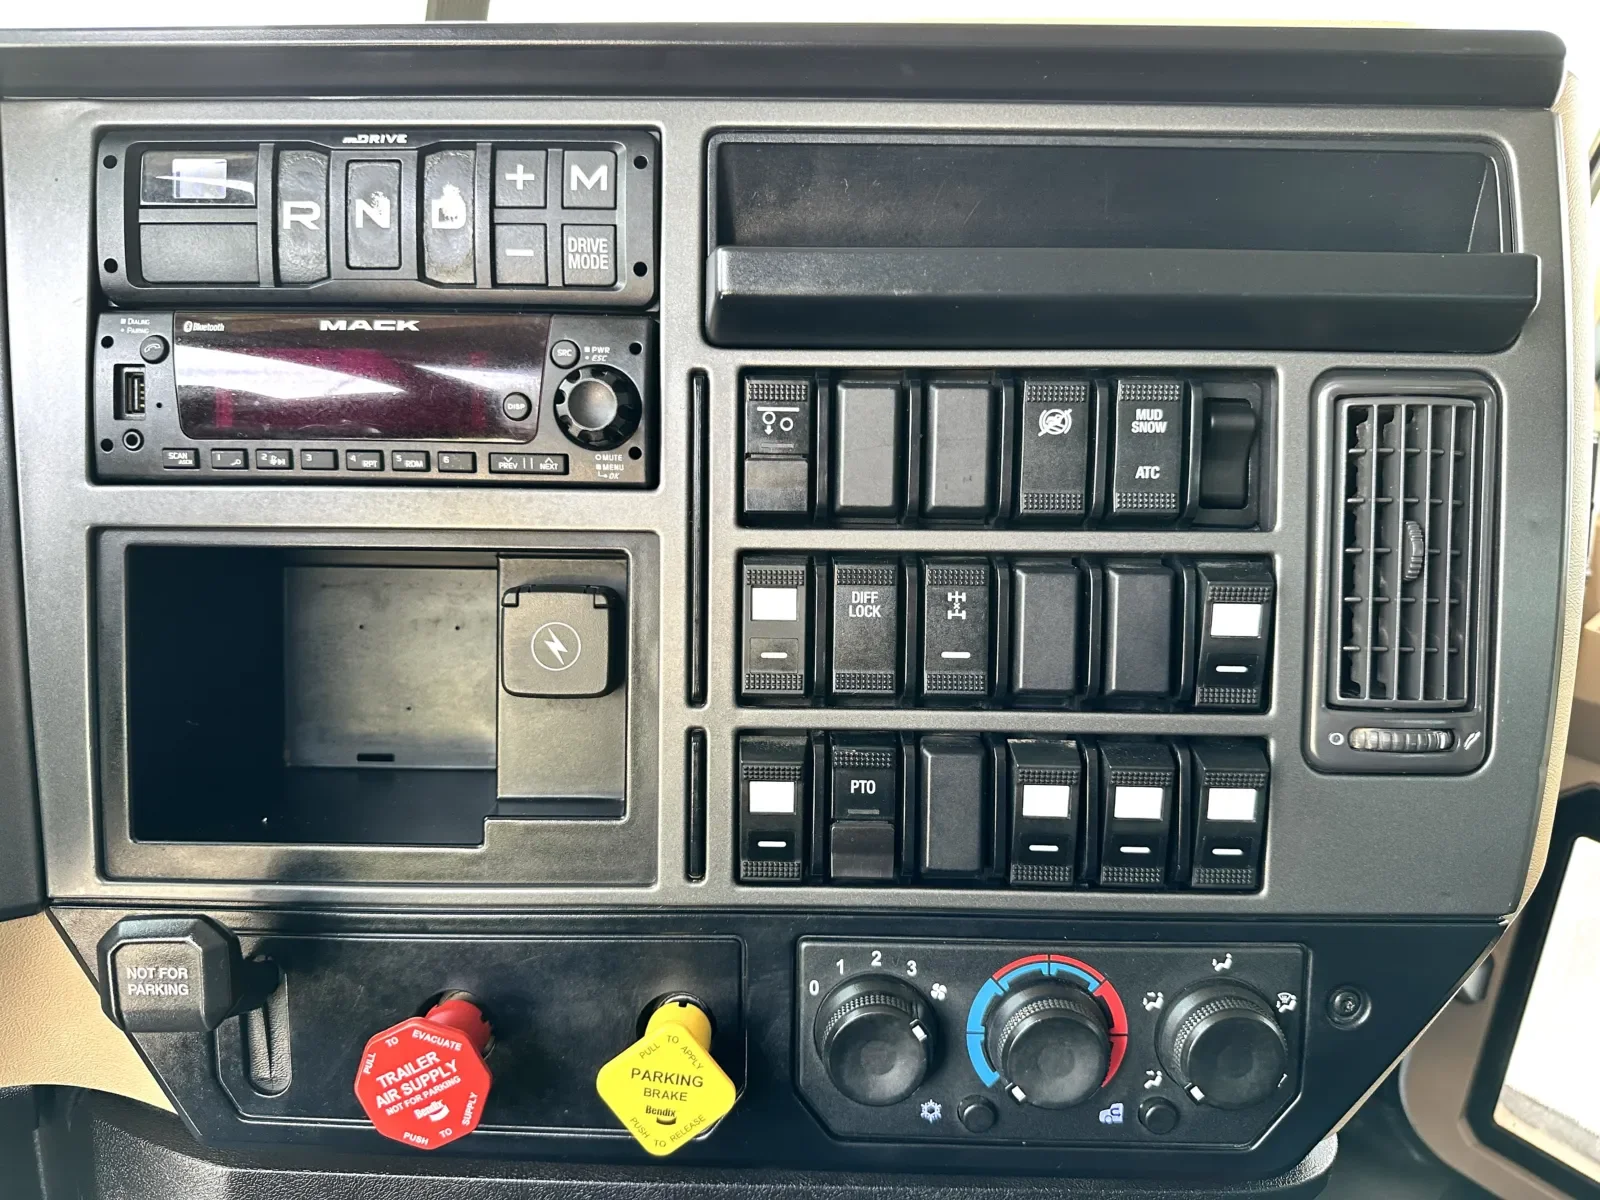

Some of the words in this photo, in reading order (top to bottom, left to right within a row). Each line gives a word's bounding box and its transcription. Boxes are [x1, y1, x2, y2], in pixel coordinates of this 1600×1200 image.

[570, 164, 608, 191] M
[282, 201, 321, 229] R
[355, 198, 391, 229] N
[431, 198, 467, 229] D
[568, 237, 608, 253] DRIVE
[568, 253, 609, 270] MODE
[193, 322, 225, 332] Bluetooth
[319, 320, 421, 331] MACK
[557, 349, 573, 357] SRC
[591, 346, 611, 354] PWR
[1135, 408, 1164, 421] MUD
[1131, 420, 1168, 434] SNOW
[168, 452, 188, 460] SCAN
[216, 453, 221, 461] 1
[261, 453, 268, 461] 2
[306, 453, 313, 462] 3
[443, 456, 450, 464] 6
[602, 454, 623, 462] MUTE
[361, 460, 378, 468] RPT
[404, 460, 424, 468] RDM
[498, 462, 518, 470] PREV
[539, 463, 559, 471] NEXT
[602, 463, 625, 471] MENU
[608, 472, 620, 480] OK
[1135, 466, 1161, 480] ATC
[851, 591, 879, 604] DIFF
[849, 604, 882, 618] LOCK
[850, 779, 876, 794] PTO
[870, 950, 882, 967] 2
[126, 967, 155, 980] NOT
[159, 967, 188, 980] FOR
[836, 958, 845, 975] 1
[906, 960, 918, 977] 3
[127, 983, 190, 996] PARKING
[808, 979, 820, 996] 0
[362, 1052, 377, 1076] PULL
[384, 1036, 399, 1048] TO
[411, 1029, 463, 1052] EVACUATE
[639, 1041, 661, 1060] PULL
[666, 1034, 680, 1044] TO
[680, 1045, 704, 1071] APPLY
[375, 1051, 441, 1089] TRAILER
[375, 1088, 402, 1109] AIR
[400, 1058, 458, 1097] SUPPLY
[631, 1067, 704, 1088] PARKING
[384, 1102, 405, 1117] NOT
[404, 1093, 423, 1108] FOR
[423, 1075, 462, 1100] PARKING
[643, 1087, 688, 1102] BRAKE
[413, 1099, 445, 1120] Bendix
[645, 1104, 676, 1118] Bendix
[403, 1131, 429, 1146] PUSH
[438, 1127, 453, 1139] TO
[461, 1091, 478, 1126] SUPPLY
[629, 1116, 651, 1140] PUSH
[653, 1139, 667, 1148] TO
[669, 1114, 707, 1143] RELEASE
